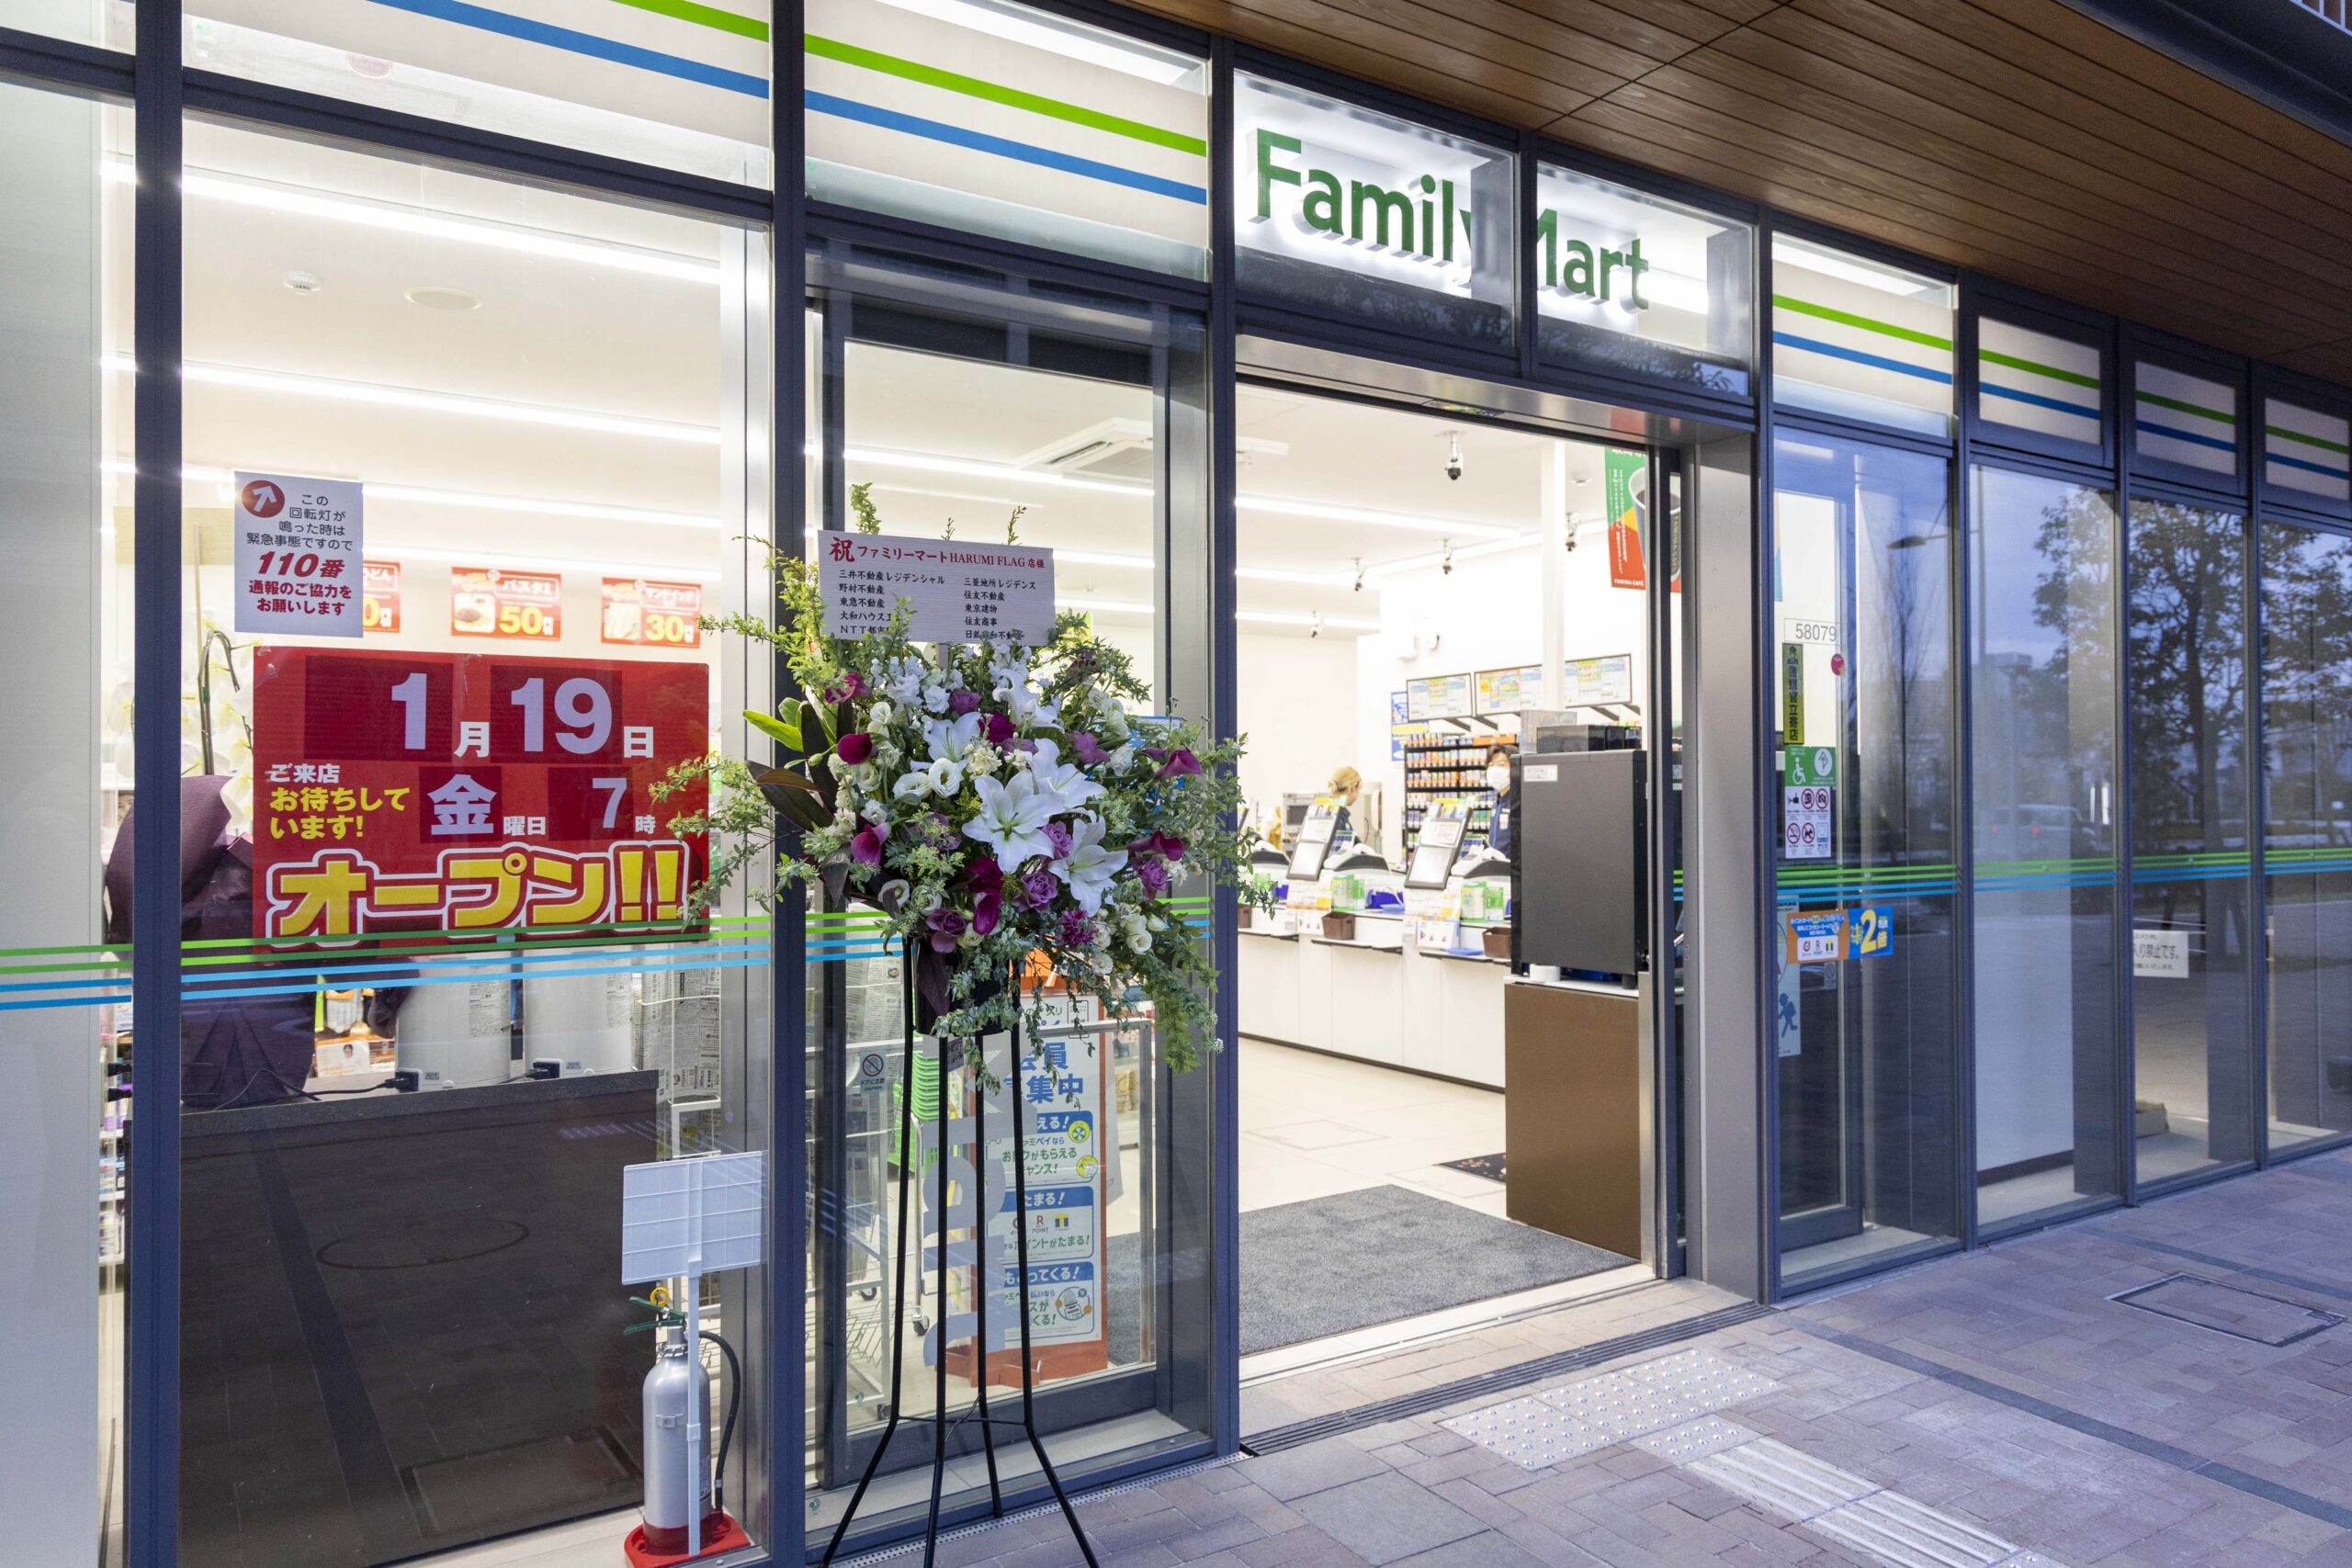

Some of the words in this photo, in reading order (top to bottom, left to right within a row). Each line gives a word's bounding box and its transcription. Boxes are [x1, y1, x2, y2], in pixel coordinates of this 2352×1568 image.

[301, 494, 329, 506] この
[289, 506, 345, 522] 回転灯が
[278, 521, 345, 536] 鳴った時は
[246, 532, 353, 551] 緊急事態ですので
[829, 536, 854, 562] 祝
[949, 553, 995, 566] HARUMI
[997, 555, 1025, 568] FLAG
[1027, 558, 1045, 569] 店様
[258, 551, 345, 578] 110番
[839, 570, 944, 585] 三井不動産レジデンシャル
[964, 577, 1036, 590] 三菱地所レジデンス
[249, 580, 352, 599] 通報のご協力を
[838, 583, 885, 595] 野村不動産
[964, 590, 1005, 602] 住友不動産
[257, 598, 345, 615] お願いします
[839, 597, 885, 609] 東急不動産
[965, 604, 998, 614] 東京建物
[965, 616, 998, 627] 住友商事
[1795, 623, 1837, 642] 58079
[266, 762, 341, 784] ご来店
[269, 785, 412, 813] お待ちして
[269, 815, 364, 840] います!
[268, 842, 687, 944] オープン!!
